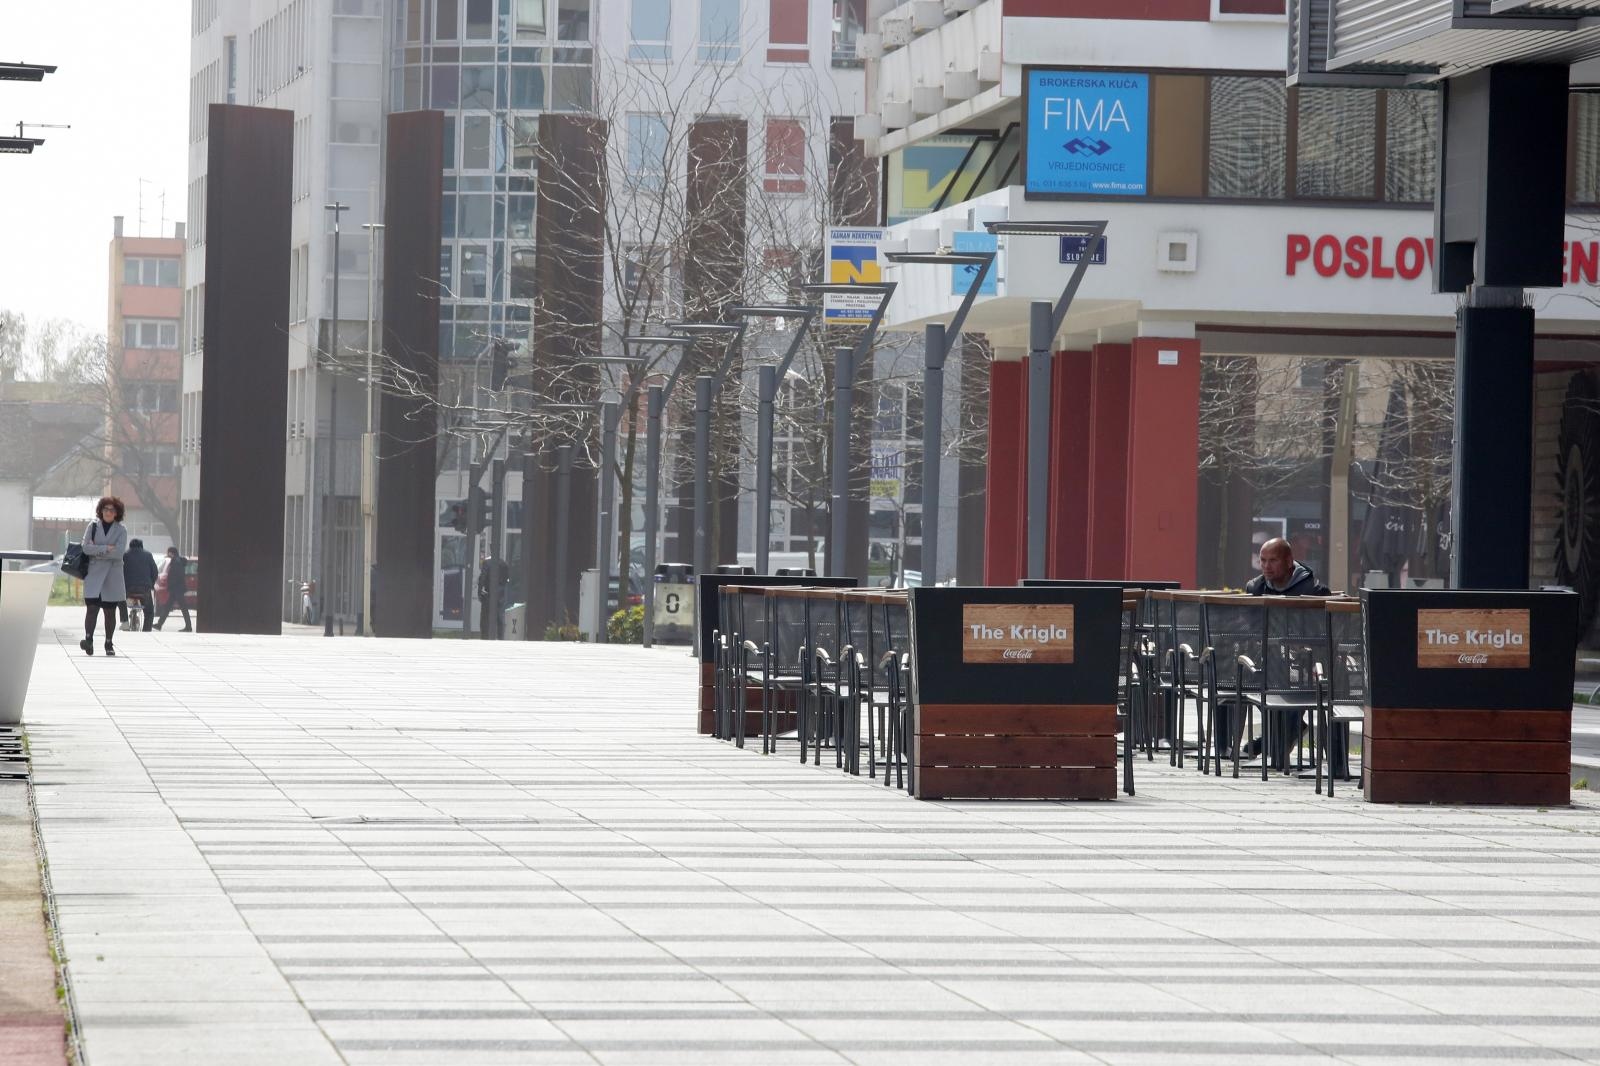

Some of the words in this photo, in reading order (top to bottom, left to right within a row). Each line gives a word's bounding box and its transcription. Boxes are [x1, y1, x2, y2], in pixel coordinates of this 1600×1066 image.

[1039, 78, 1106, 88] BROKERSKA
[1108, 77, 1138, 89] KUĆA
[1044, 97, 1130, 132] FIMA
[1048, 161, 1126, 172] VRIJEDNOSNICE
[1092, 182, 1143, 190] www.fima.com
[970, 623, 1004, 640] The
[1010, 623, 1067, 643] Krigla
[1425, 629, 1459, 645] The
[1465, 629, 1523, 649] Krigla
